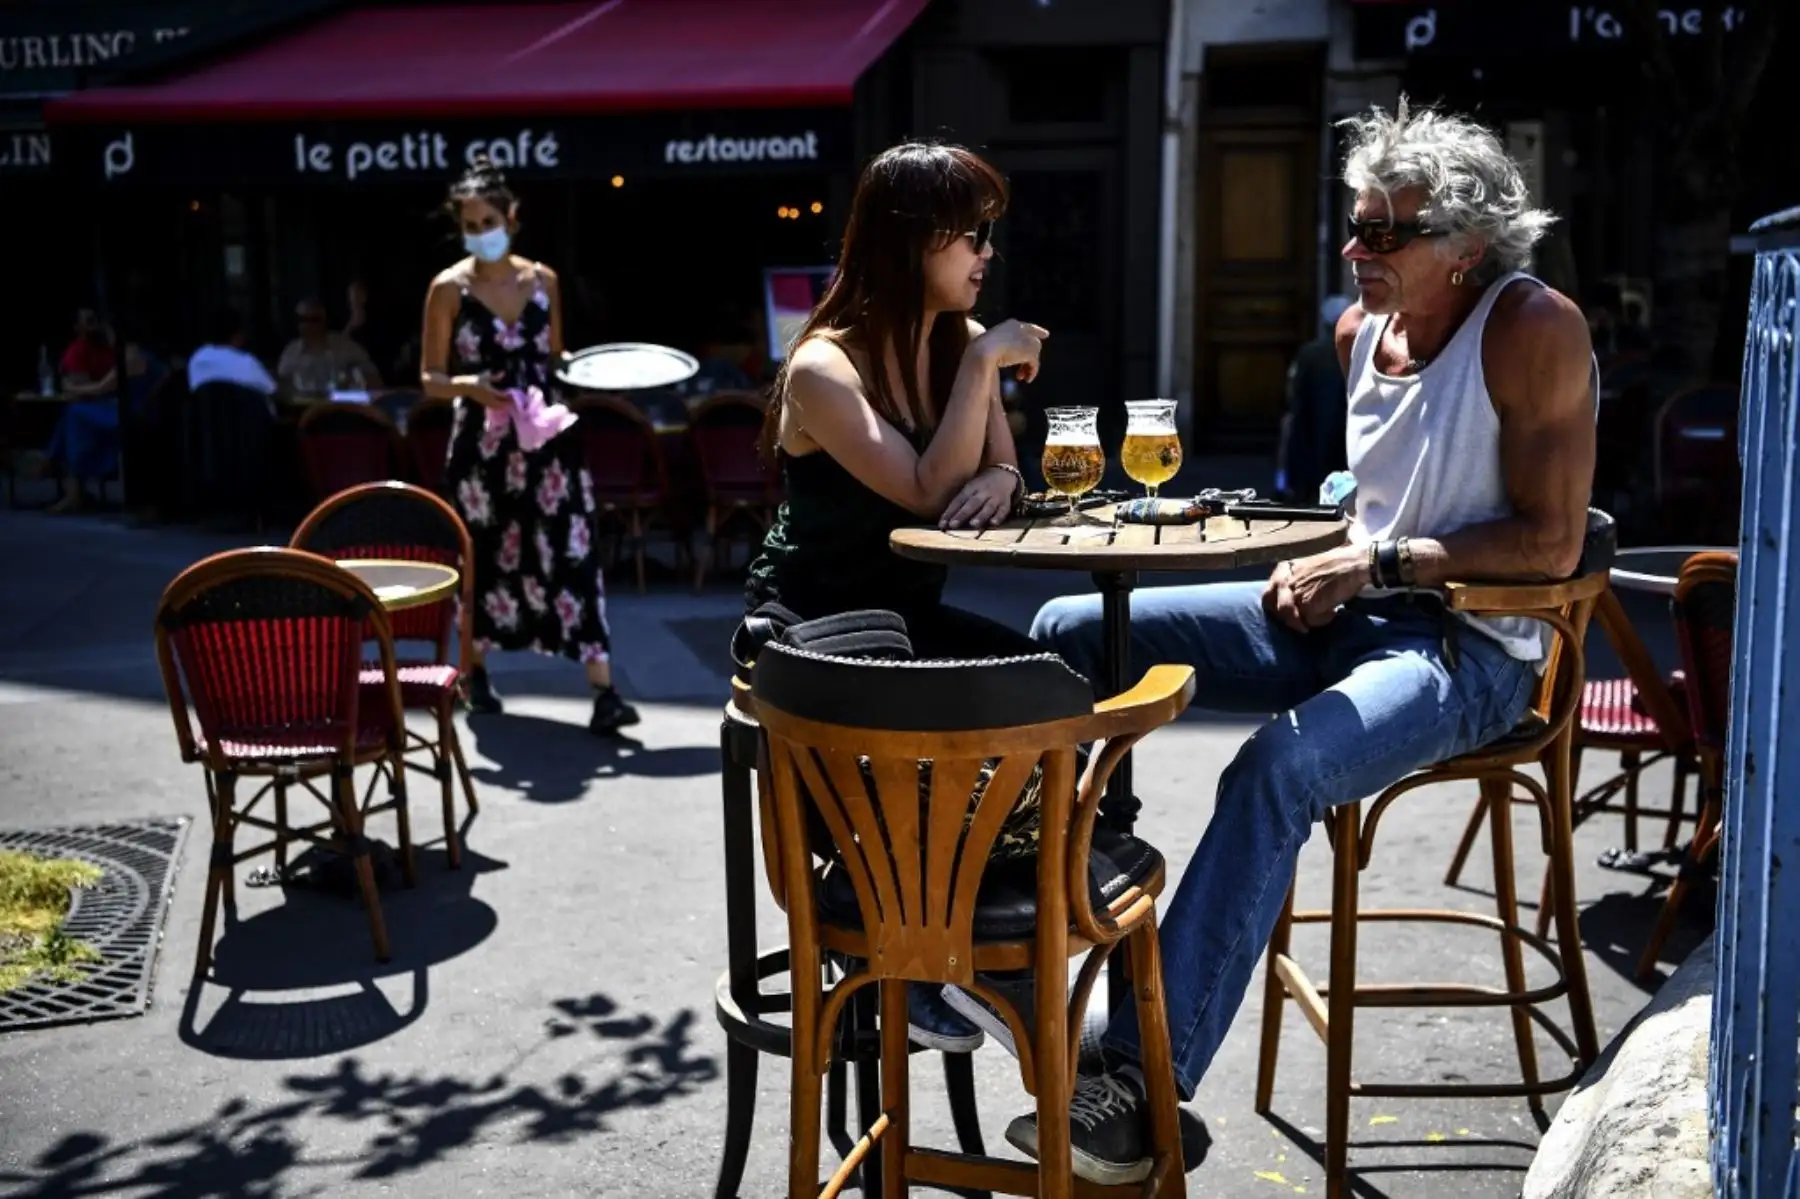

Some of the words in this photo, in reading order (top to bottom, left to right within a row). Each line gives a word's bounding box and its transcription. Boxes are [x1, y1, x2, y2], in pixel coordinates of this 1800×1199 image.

[294, 131, 334, 172] le
[345, 129, 449, 181] petit
[463, 127, 560, 169] café
[665, 129, 819, 163] restaurant
